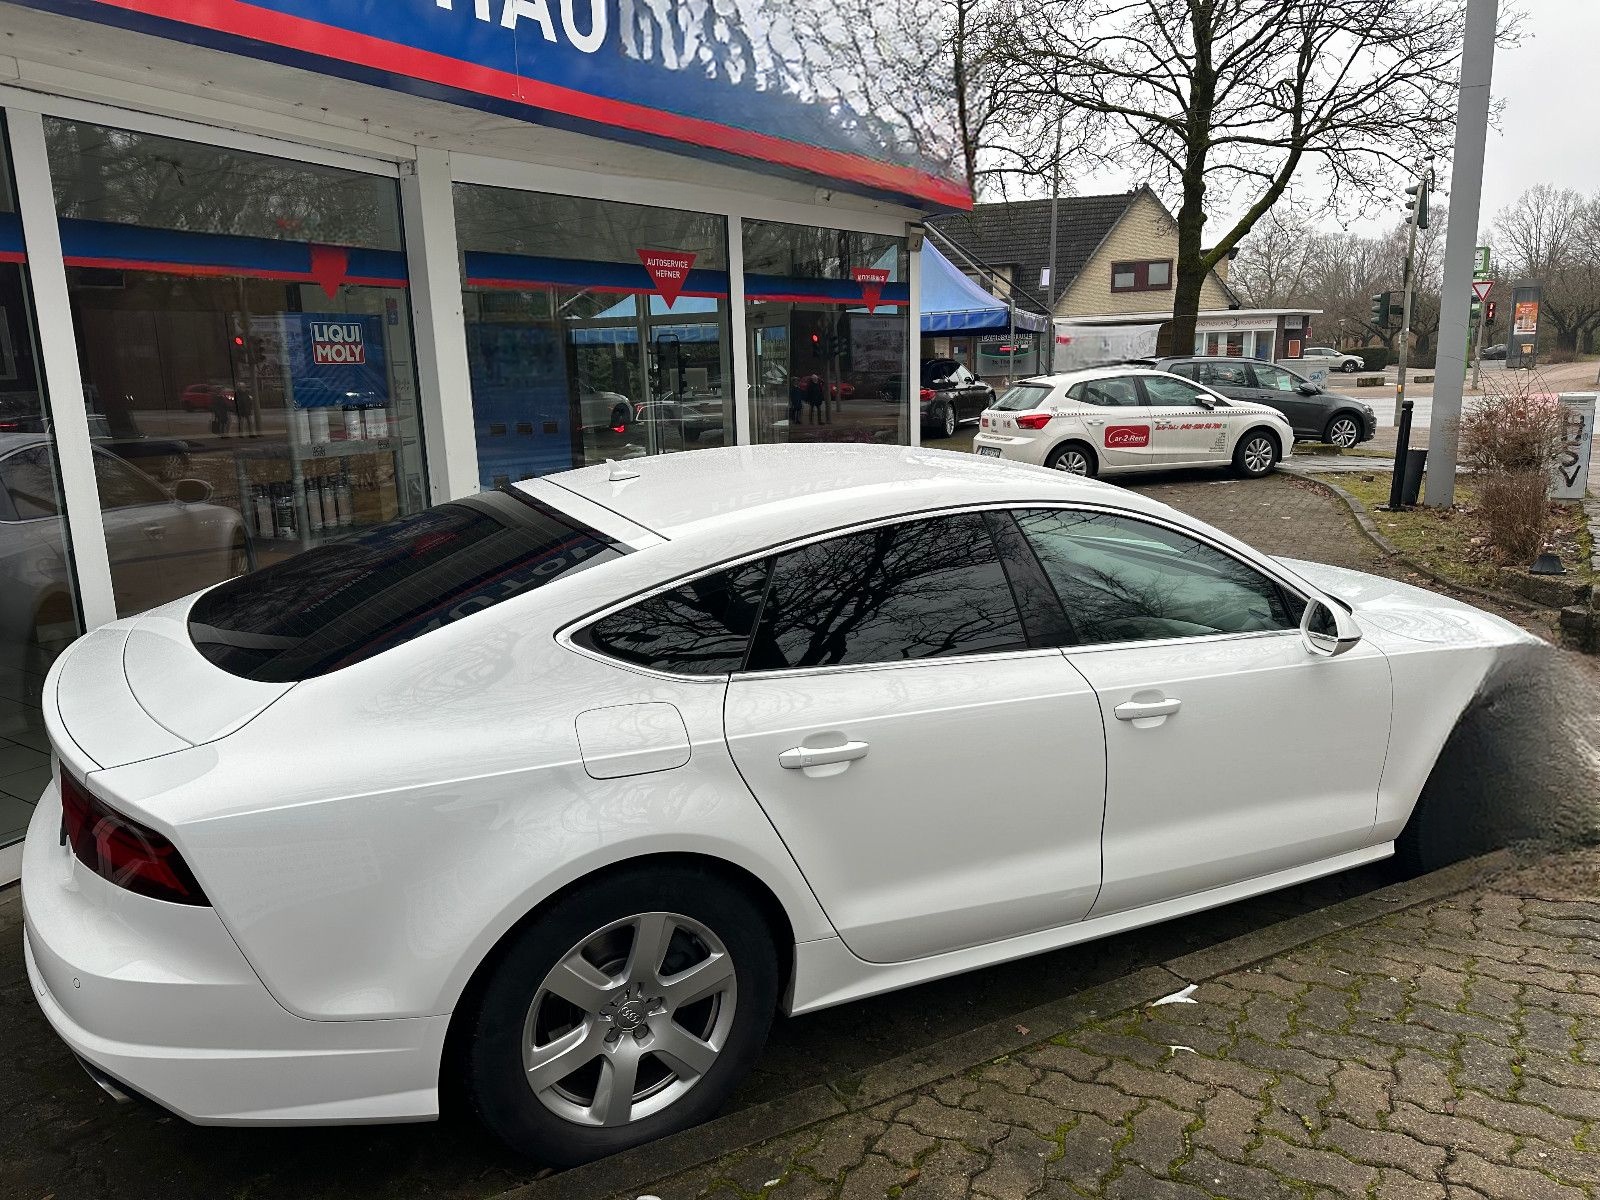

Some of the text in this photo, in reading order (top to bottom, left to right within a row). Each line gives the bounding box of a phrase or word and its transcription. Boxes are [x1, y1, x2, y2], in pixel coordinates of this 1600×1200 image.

[646, 257, 689, 269] AUTOSERVICE
[655, 269, 681, 279] HEFNER
[313, 324, 360, 343] LIQUI
[315, 344, 362, 362] MOLY
